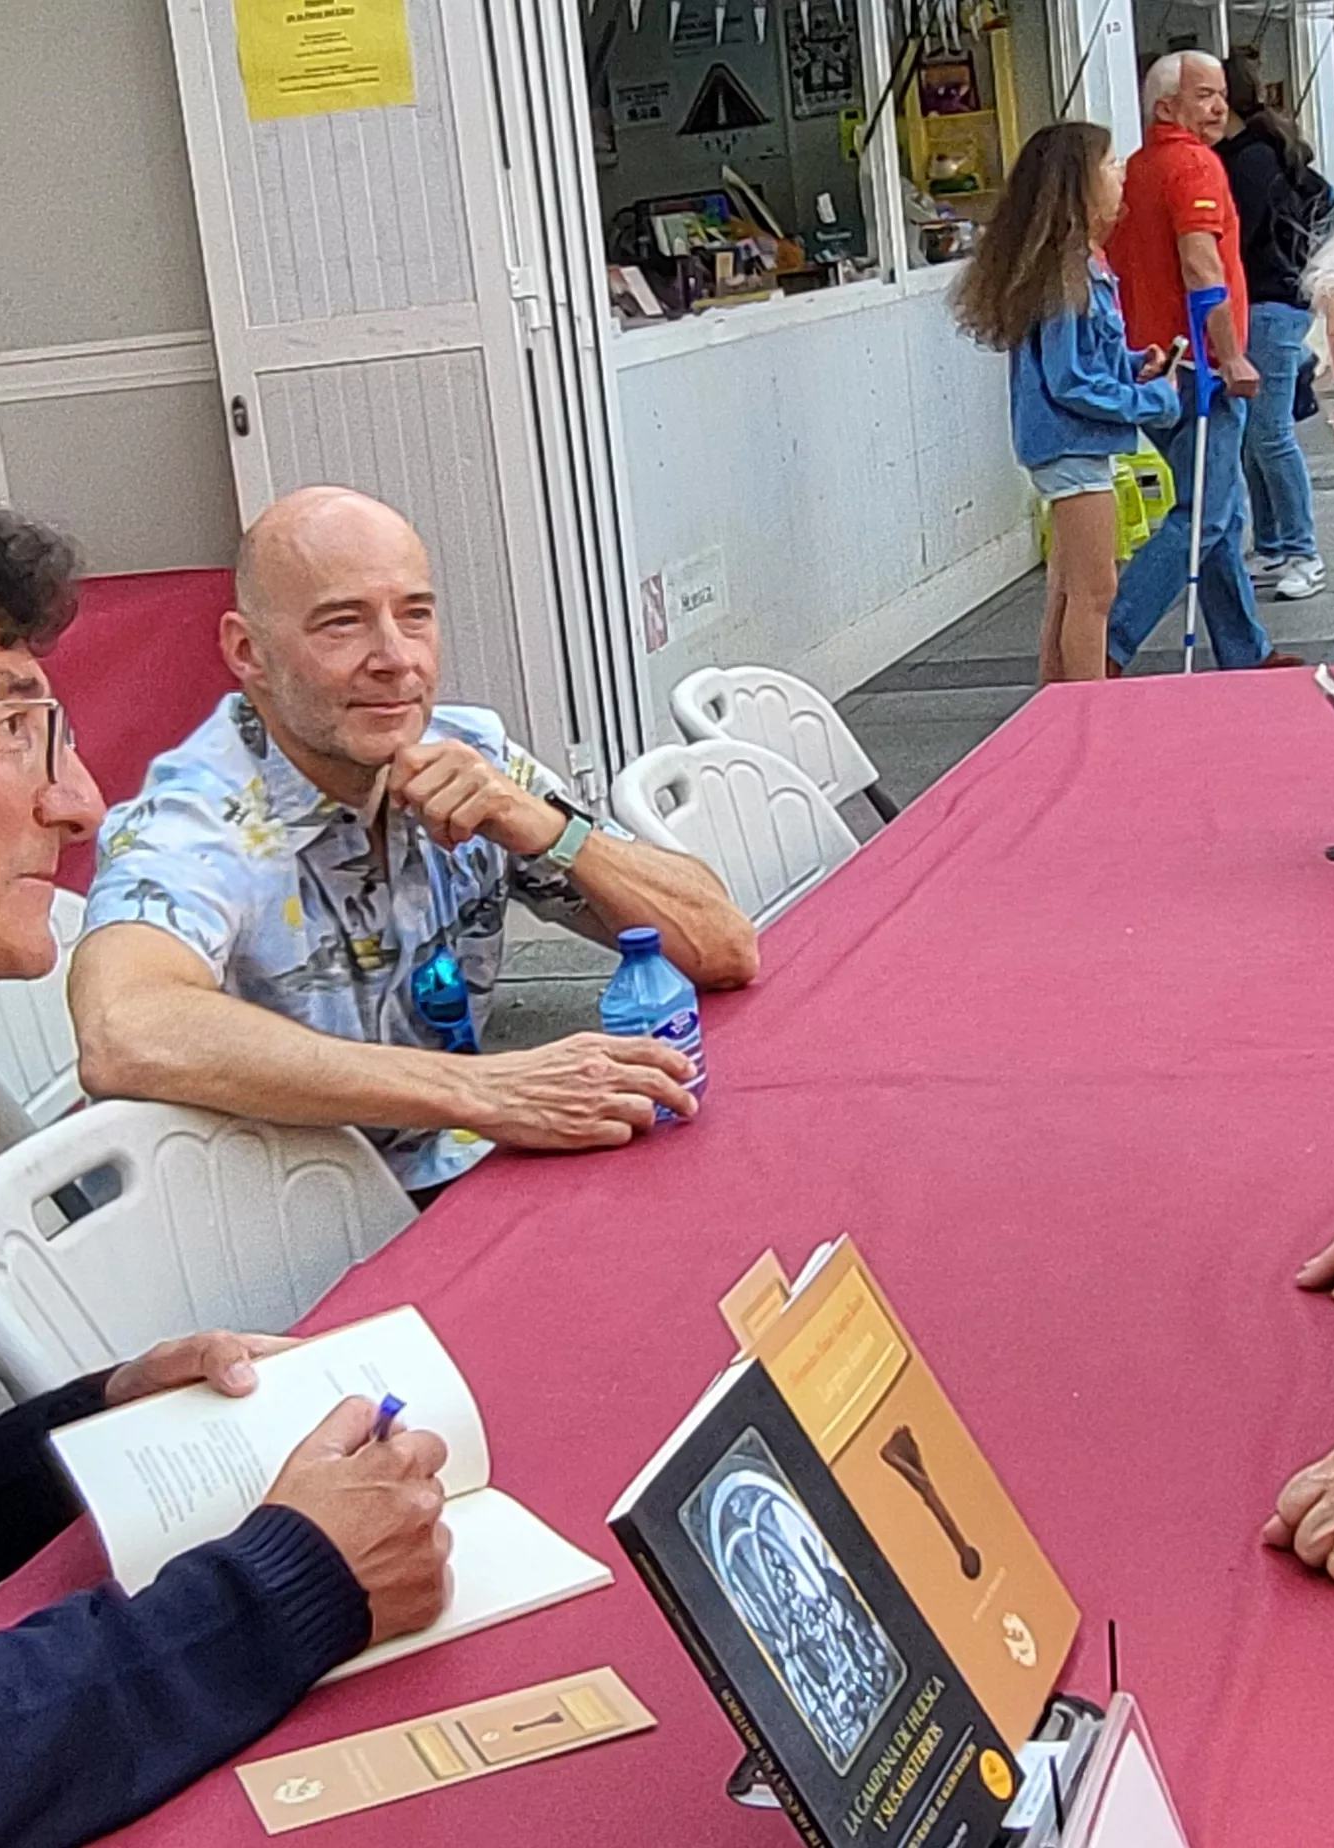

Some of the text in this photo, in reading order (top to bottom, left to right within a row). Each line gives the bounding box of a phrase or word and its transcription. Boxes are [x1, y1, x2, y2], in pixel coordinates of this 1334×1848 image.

[842, 1808, 862, 1838] LA
[854, 1745, 902, 1816] CAMPANA
[894, 1723, 914, 1752] DE
[904, 1675, 946, 1734] HUESCA
[872, 1723, 945, 1833] Y SUS MISTERIOS
